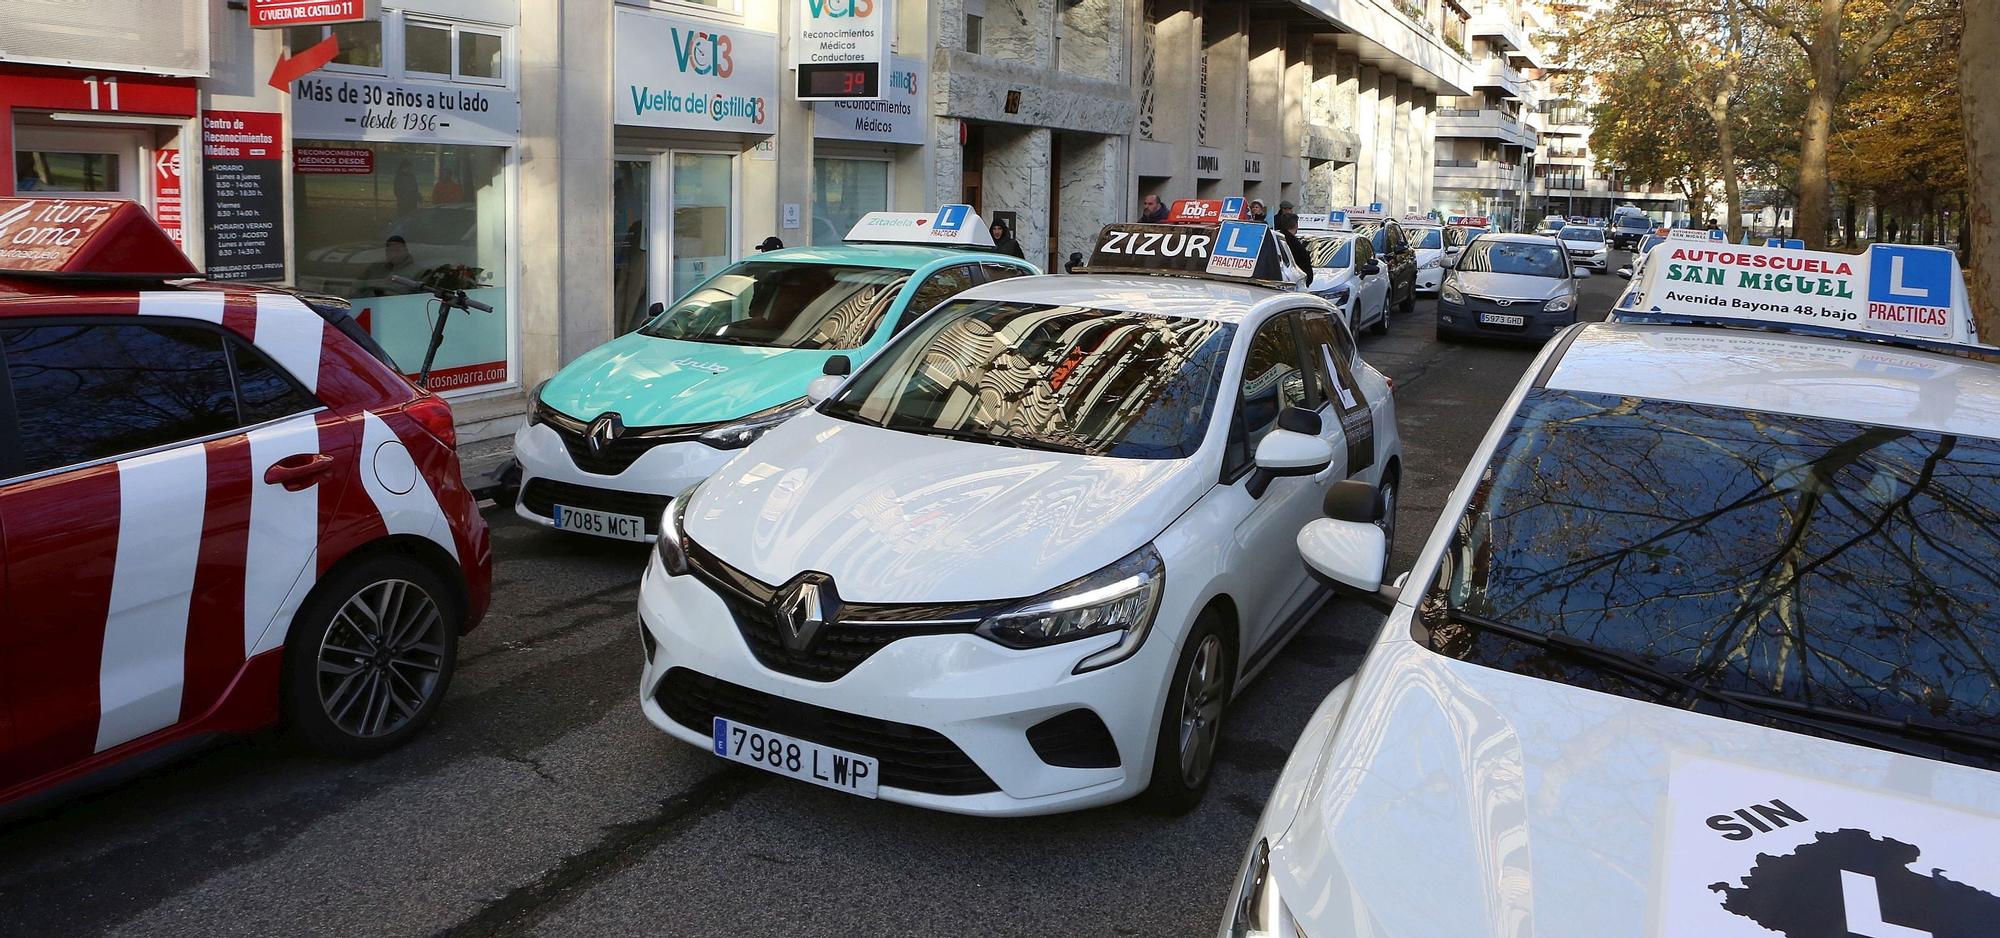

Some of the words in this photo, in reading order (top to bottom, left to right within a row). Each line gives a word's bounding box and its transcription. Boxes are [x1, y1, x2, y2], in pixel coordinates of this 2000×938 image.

[293, 7, 307, 18] DEL
[307, 4, 341, 17] CASTILLO
[342, 2, 353, 15] 11
[803, 29, 874, 39] Reconocimientos
[671, 28, 734, 78] VC13
[820, 41, 856, 50] Médicos
[811, 53, 865, 62] Conductores
[83, 75, 118, 110] 11
[297, 79, 333, 102] Más
[338, 82, 358, 104] de
[363, 85, 382, 106] 30
[386, 88, 422, 108] años
[427, 95, 435, 109] a
[439, 92, 454, 110] tu
[458, 91, 489, 112] lado
[631, 85, 682, 116] Vuelta
[685, 92, 707, 115] del
[834, 101, 911, 115] Reconocimientos
[204, 117, 231, 129] Centro
[233, 119, 244, 129] de
[360, 109, 398, 130] desde
[402, 113, 438, 132] 1986
[855, 117, 892, 132] Médicos
[204, 131, 273, 143] Reconocimientos
[204, 145, 240, 156] Médicos
[1182, 203, 1218, 217] lobi.es
[1226, 200, 1236, 212] L
[868, 217, 913, 227] Zitadela
[941, 208, 955, 226] L
[1333, 212, 1341, 221] L
[929, 230, 959, 238] PRACTICAS
[1227, 228, 1248, 253] L
[1713, 231, 1720, 239] L
[1101, 231, 1211, 258] ZIZUR
[0, 248, 59, 260] utoescuela
[1671, 248, 1853, 276] AUTOESCUELA
[1211, 256, 1254, 270] PRACTICAS
[1666, 264, 1725, 286] SAN
[1889, 256, 1928, 298] L
[1665, 290, 1728, 307] Avenida
[1731, 297, 1791, 314] Bayona
[1793, 304, 1819, 318] 48,
[1820, 306, 1858, 322] bajo
[1485, 315, 1505, 323] 5973
[1869, 303, 1947, 326] PRACTICAS
[426, 367, 506, 389] icosnavarra.com
[564, 509, 603, 532] 7085
[608, 516, 639, 538] MCT
[718, 740, 724, 749] E
[732, 727, 801, 772] 7988
[813, 749, 869, 788] LWP
[1705, 798, 1809, 841] SIN
[1840, 868, 1934, 938] L
